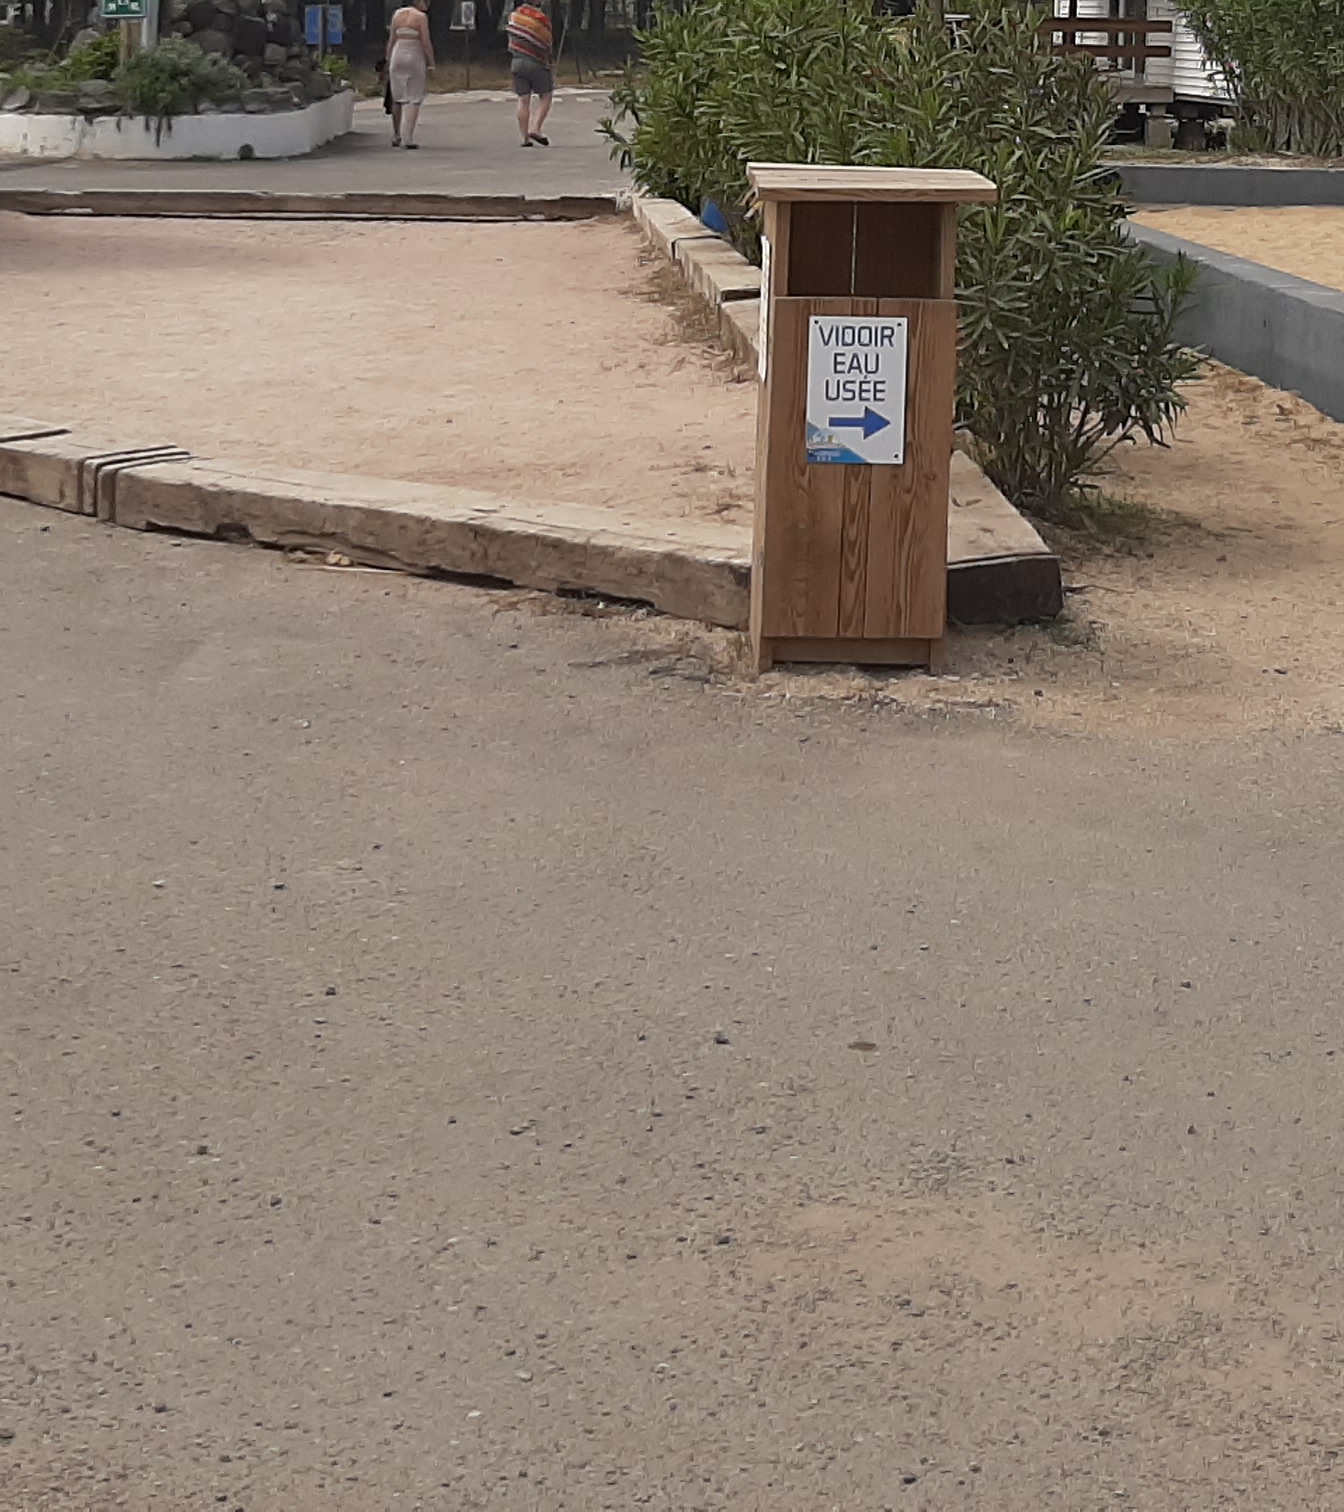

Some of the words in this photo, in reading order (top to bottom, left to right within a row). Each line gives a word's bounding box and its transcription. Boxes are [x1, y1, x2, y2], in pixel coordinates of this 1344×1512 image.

[818, 325, 895, 347] VIDOIR
[833, 352, 879, 374] EAU
[825, 375, 886, 402] USÉE
